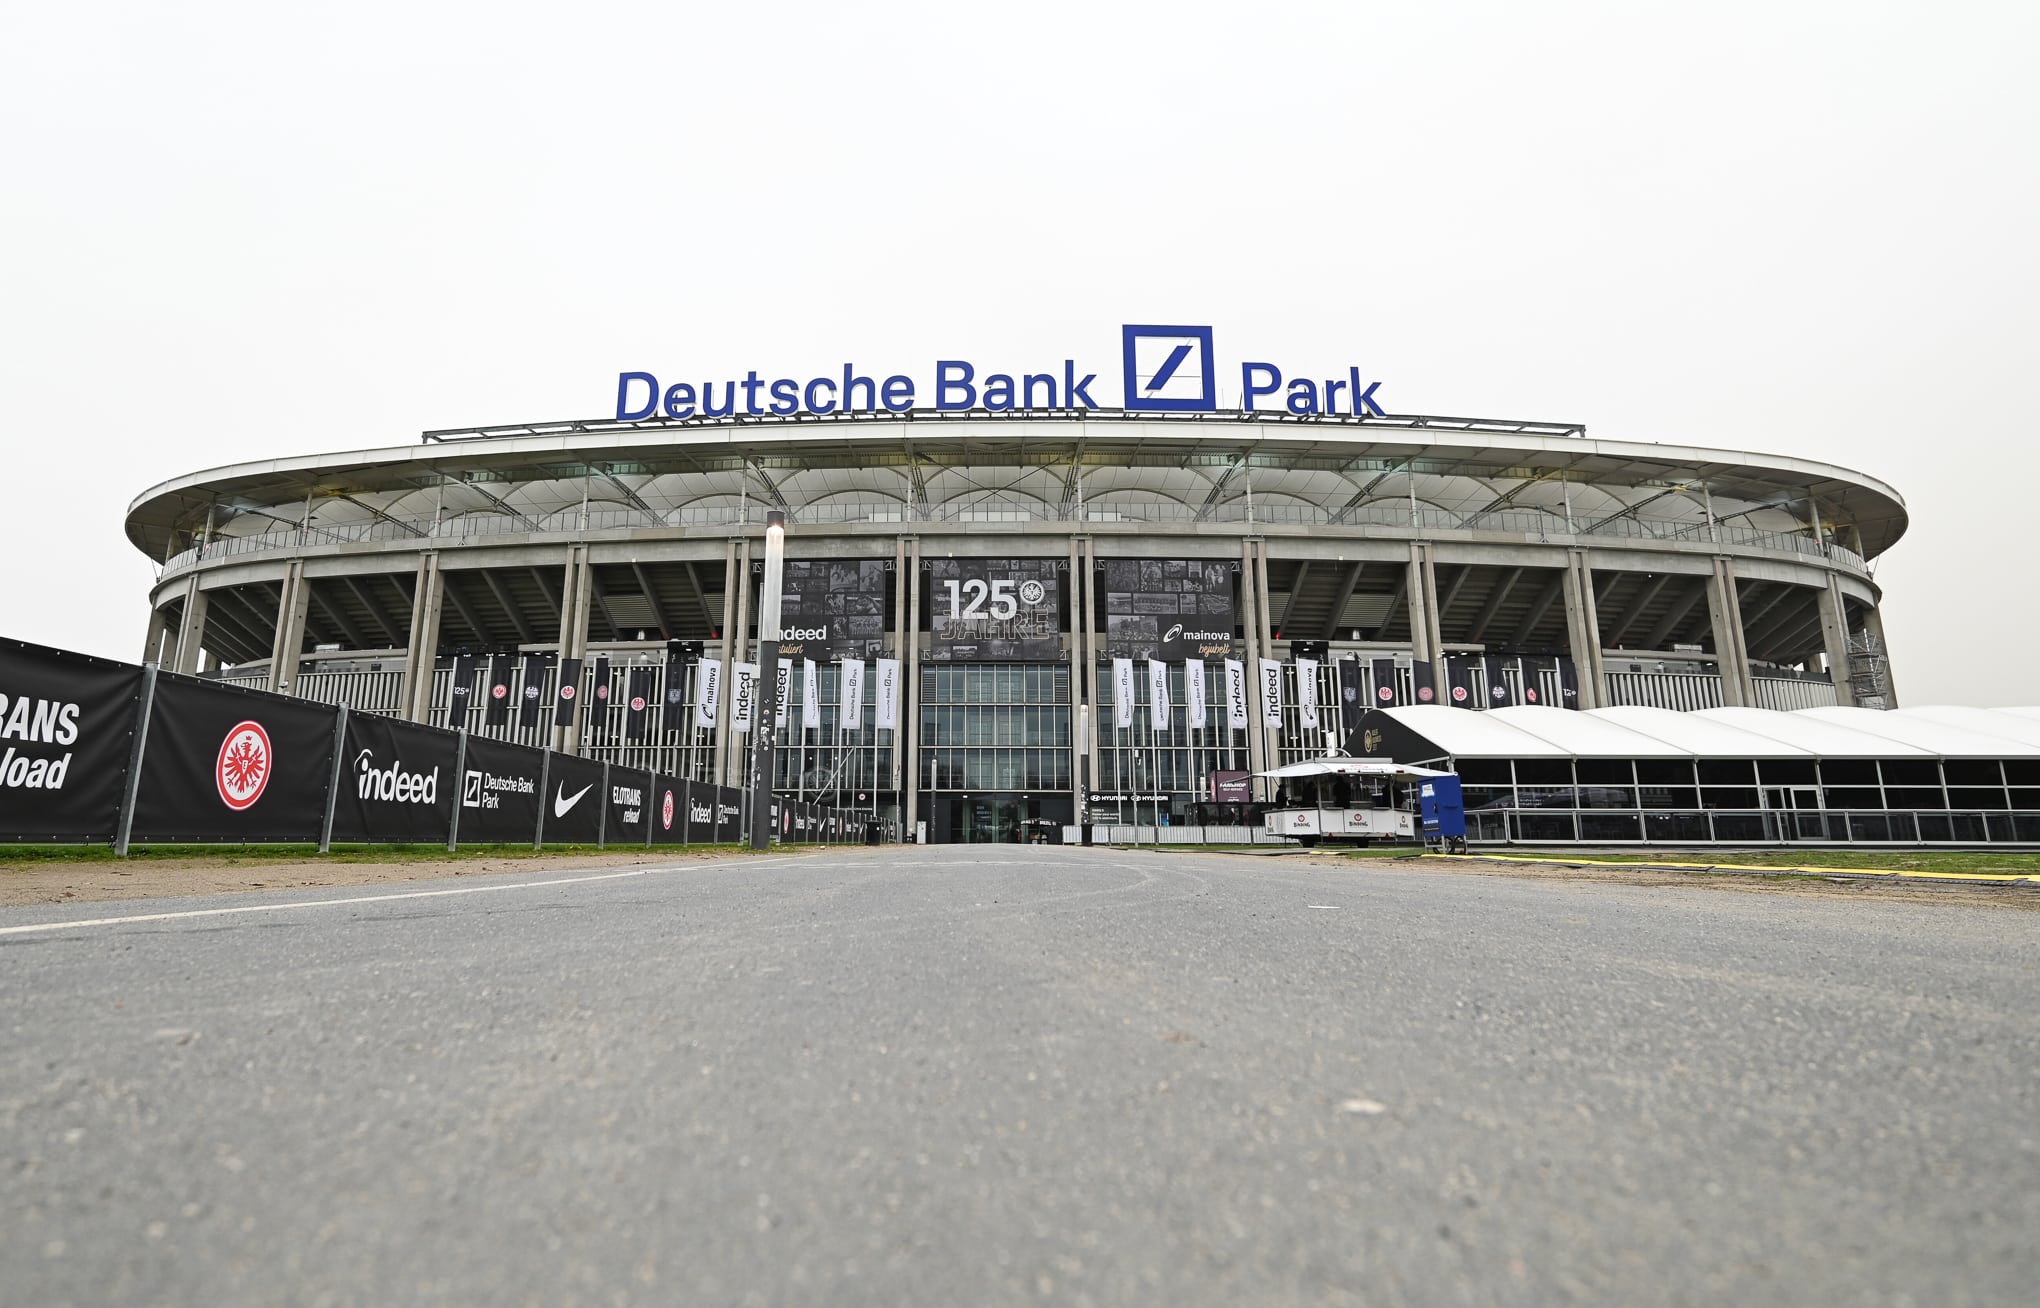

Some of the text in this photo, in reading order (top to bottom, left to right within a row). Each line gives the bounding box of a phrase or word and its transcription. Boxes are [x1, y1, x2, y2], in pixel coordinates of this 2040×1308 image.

[616, 360, 1386, 421] Deutsche Bank Park
[944, 578, 1017, 620] 125
[780, 624, 826, 640] deed
[1183, 630, 1230, 640] mainova
[778, 643, 804, 654] tuliert
[1198, 642, 1230, 658] bejubelt
[706, 668, 716, 704] mainova
[735, 672, 750, 720] indeed
[776, 668, 788, 716] indeed
[1230, 668, 1243, 718] indeed
[1266, 668, 1279, 716] indeed
[357, 756, 439, 804] indeed
[484, 772, 534, 794] Deutsche Bank
[482, 792, 500, 809] Park
[612, 786, 641, 806] ELOTRANS
[690, 800, 712, 823] indeed
